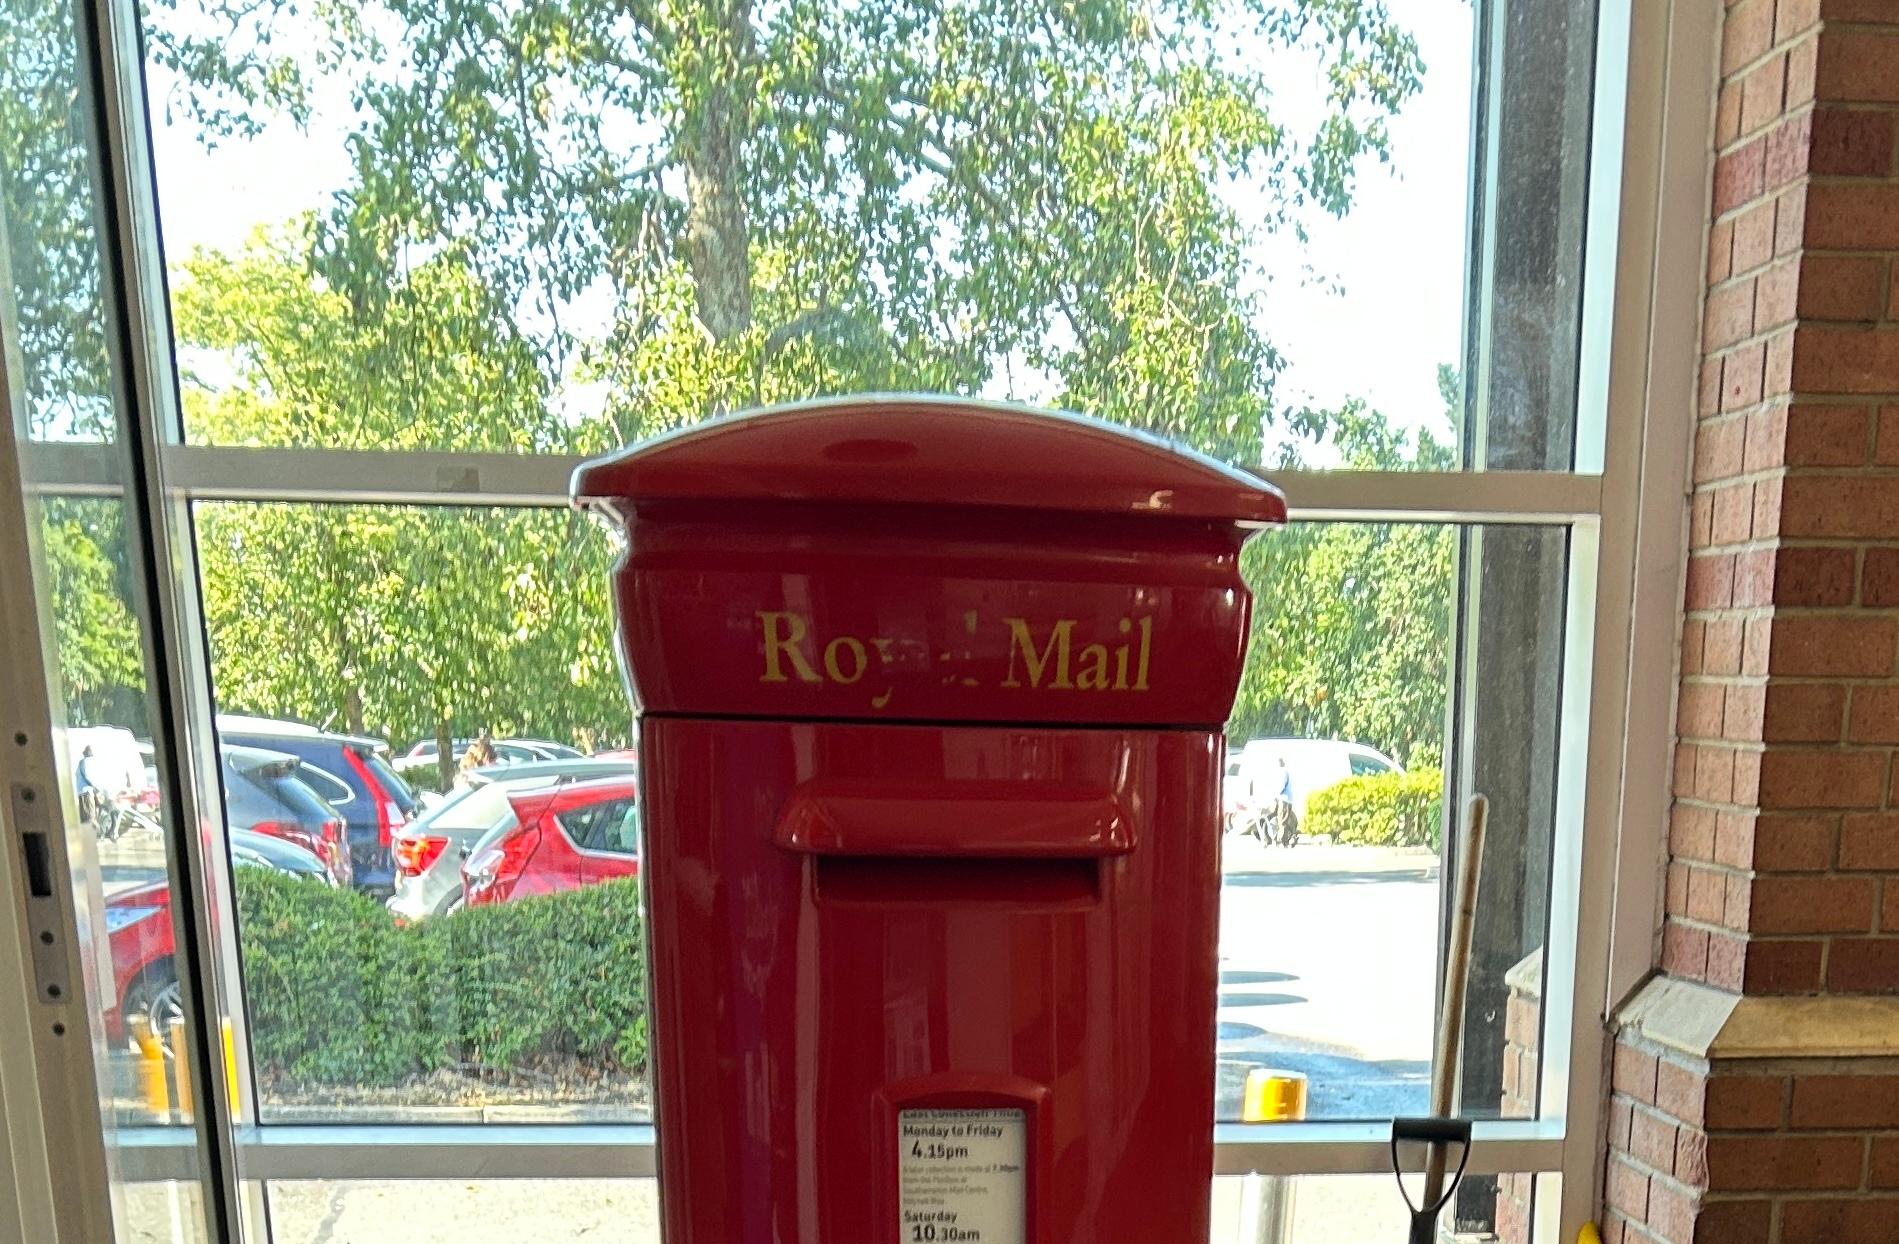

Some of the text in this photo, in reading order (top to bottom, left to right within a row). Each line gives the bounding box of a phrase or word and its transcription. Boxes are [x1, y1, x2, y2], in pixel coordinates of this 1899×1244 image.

[755, 609, 1152, 707] Roy Mail
[903, 1123, 1003, 1139] Monday to Friday
[911, 1140, 969, 1161] 4.15pm
[904, 1210, 957, 1223] Saturday
[912, 1224, 980, 1242] 10.30am
